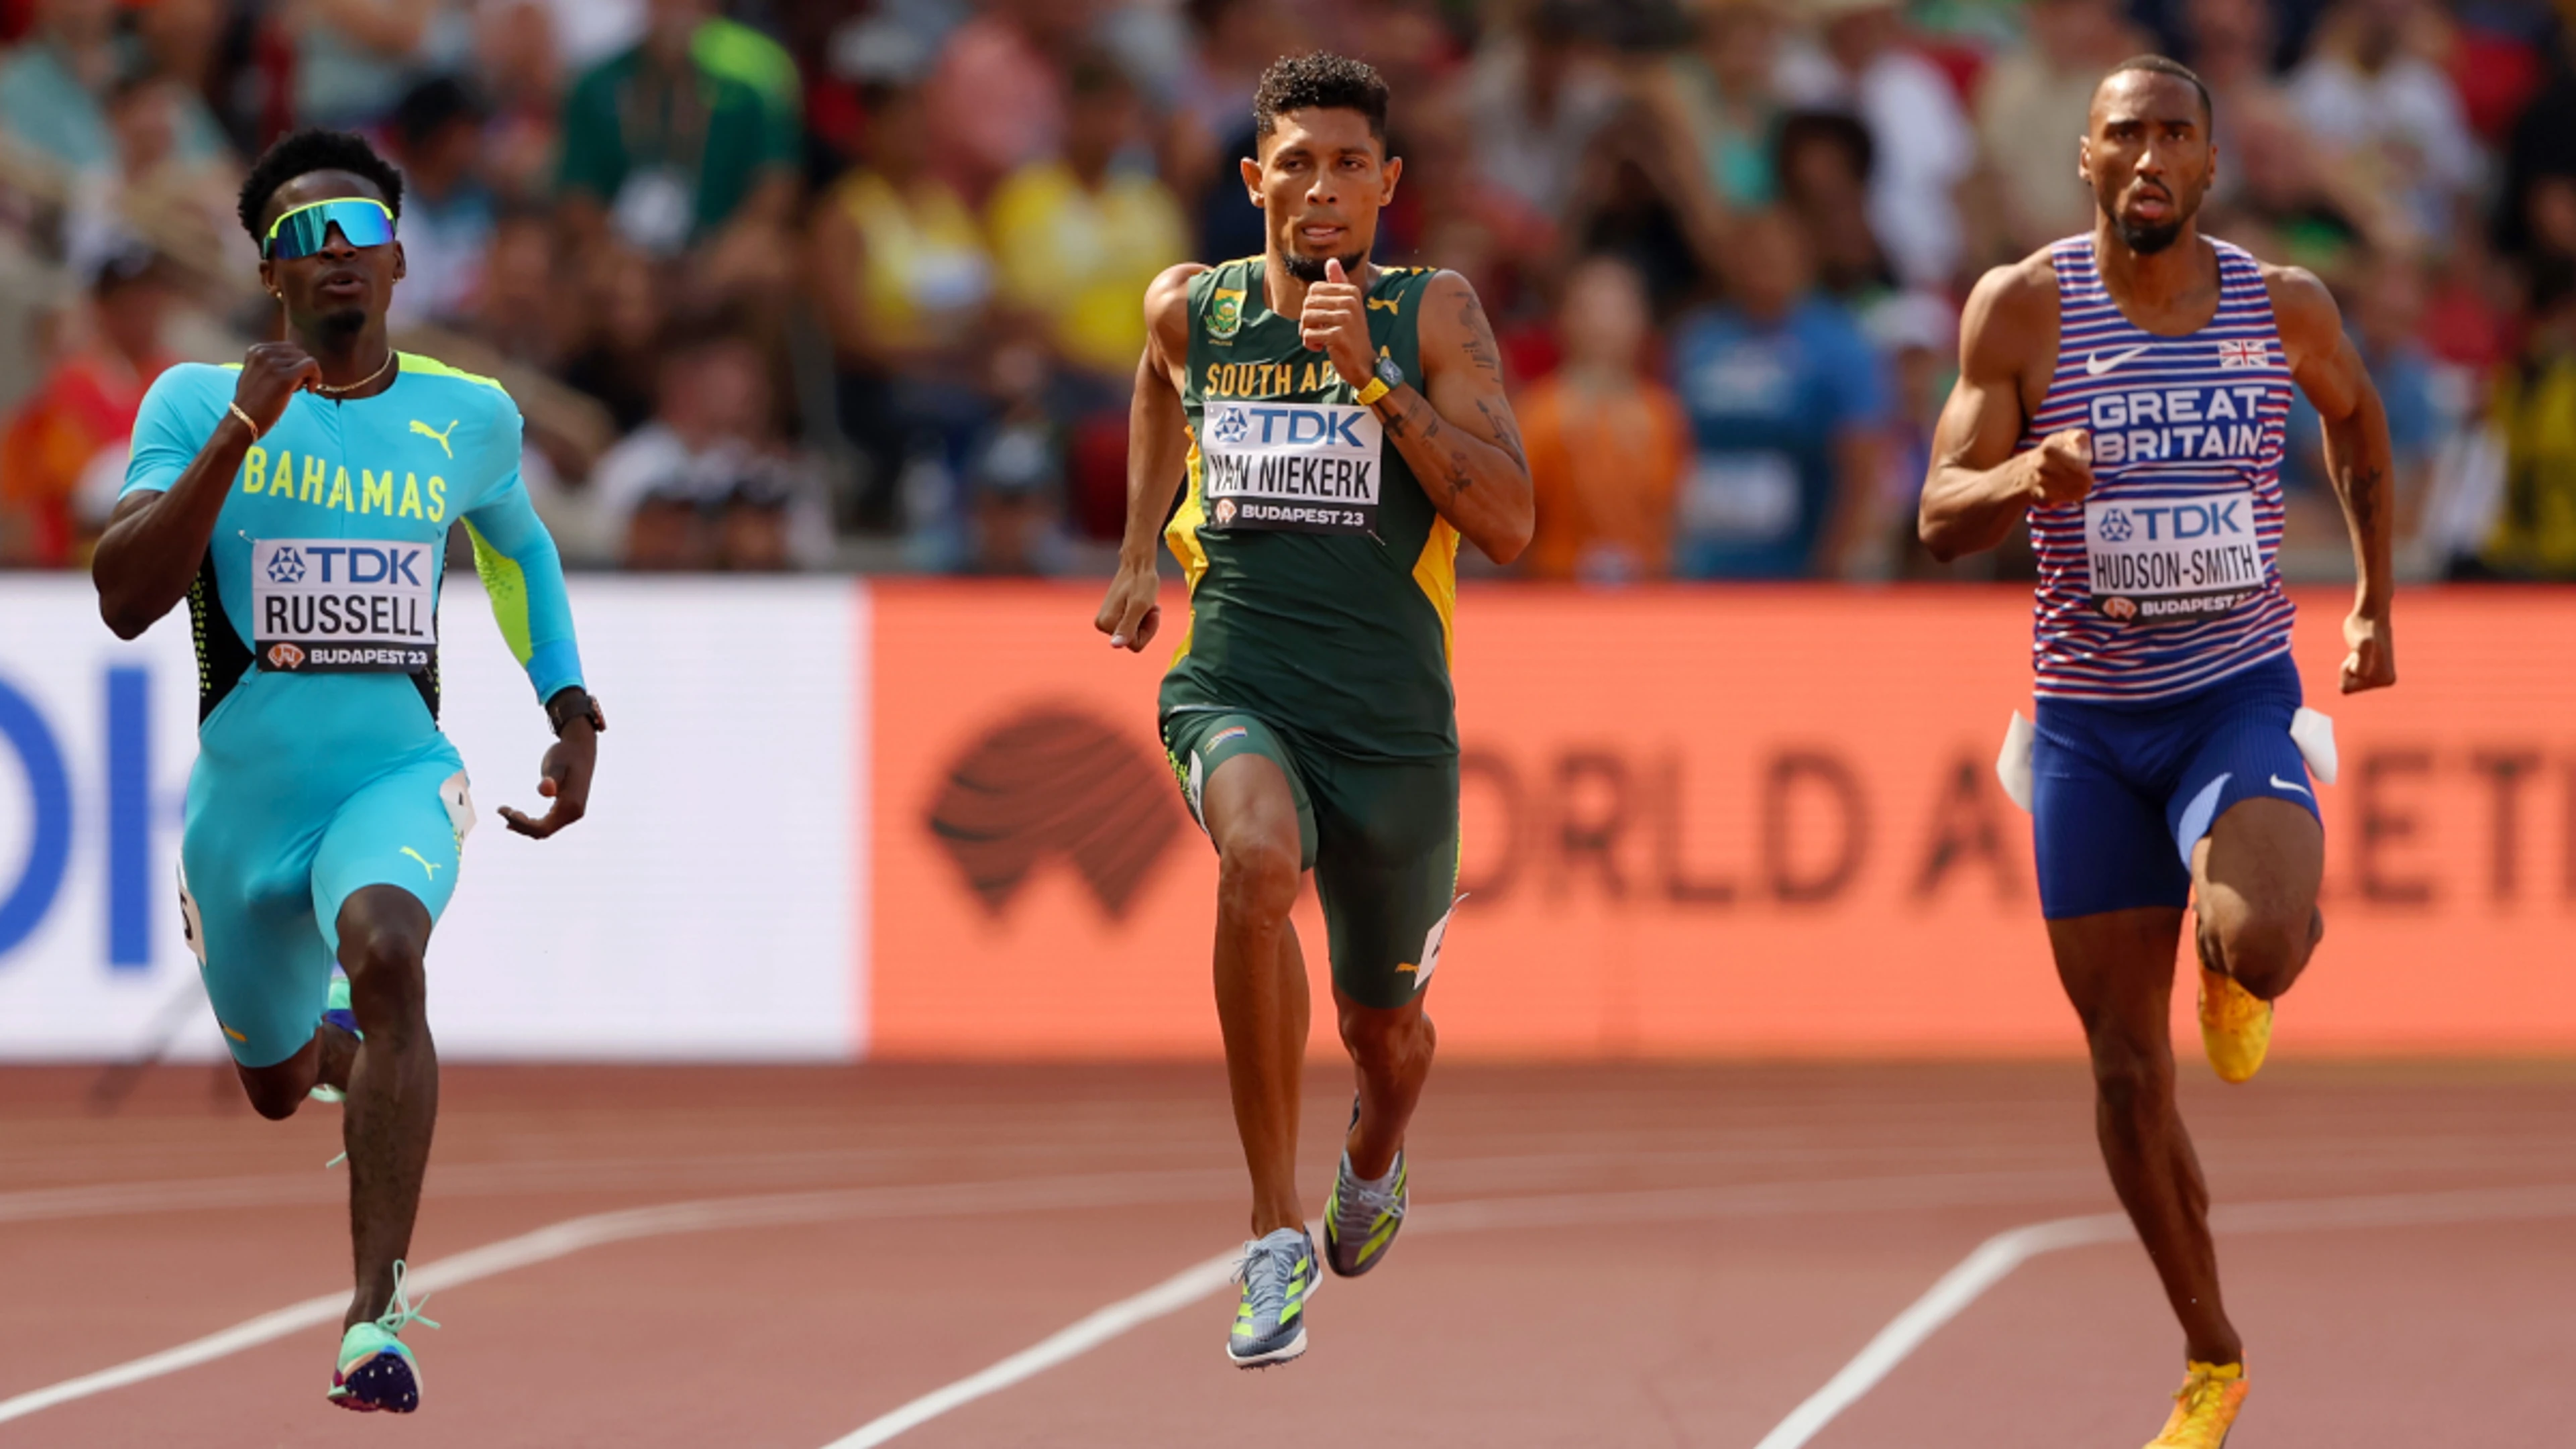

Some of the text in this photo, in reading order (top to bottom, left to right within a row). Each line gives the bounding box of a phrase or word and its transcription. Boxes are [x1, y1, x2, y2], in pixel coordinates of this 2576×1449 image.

[1205, 362, 1292, 397] SOUTH
[2090, 386, 2266, 427] GREAT
[1250, 408, 1366, 447] TDK
[2094, 424, 2264, 462] BRITAIN
[243, 445, 447, 523] BAHAMAS
[1210, 455, 1371, 499] VAN NIEKERK
[1241, 503, 1364, 527] BUDAPEST 23
[2131, 499, 2241, 541] TDK
[306, 547, 421, 586] TDK
[2094, 543, 2257, 591] HUDSON-SMITH
[265, 594, 424, 637] RUSSELL
[2141, 594, 2235, 618] BUDAPEST
[311, 649, 428, 664] BUDAPEST 23
